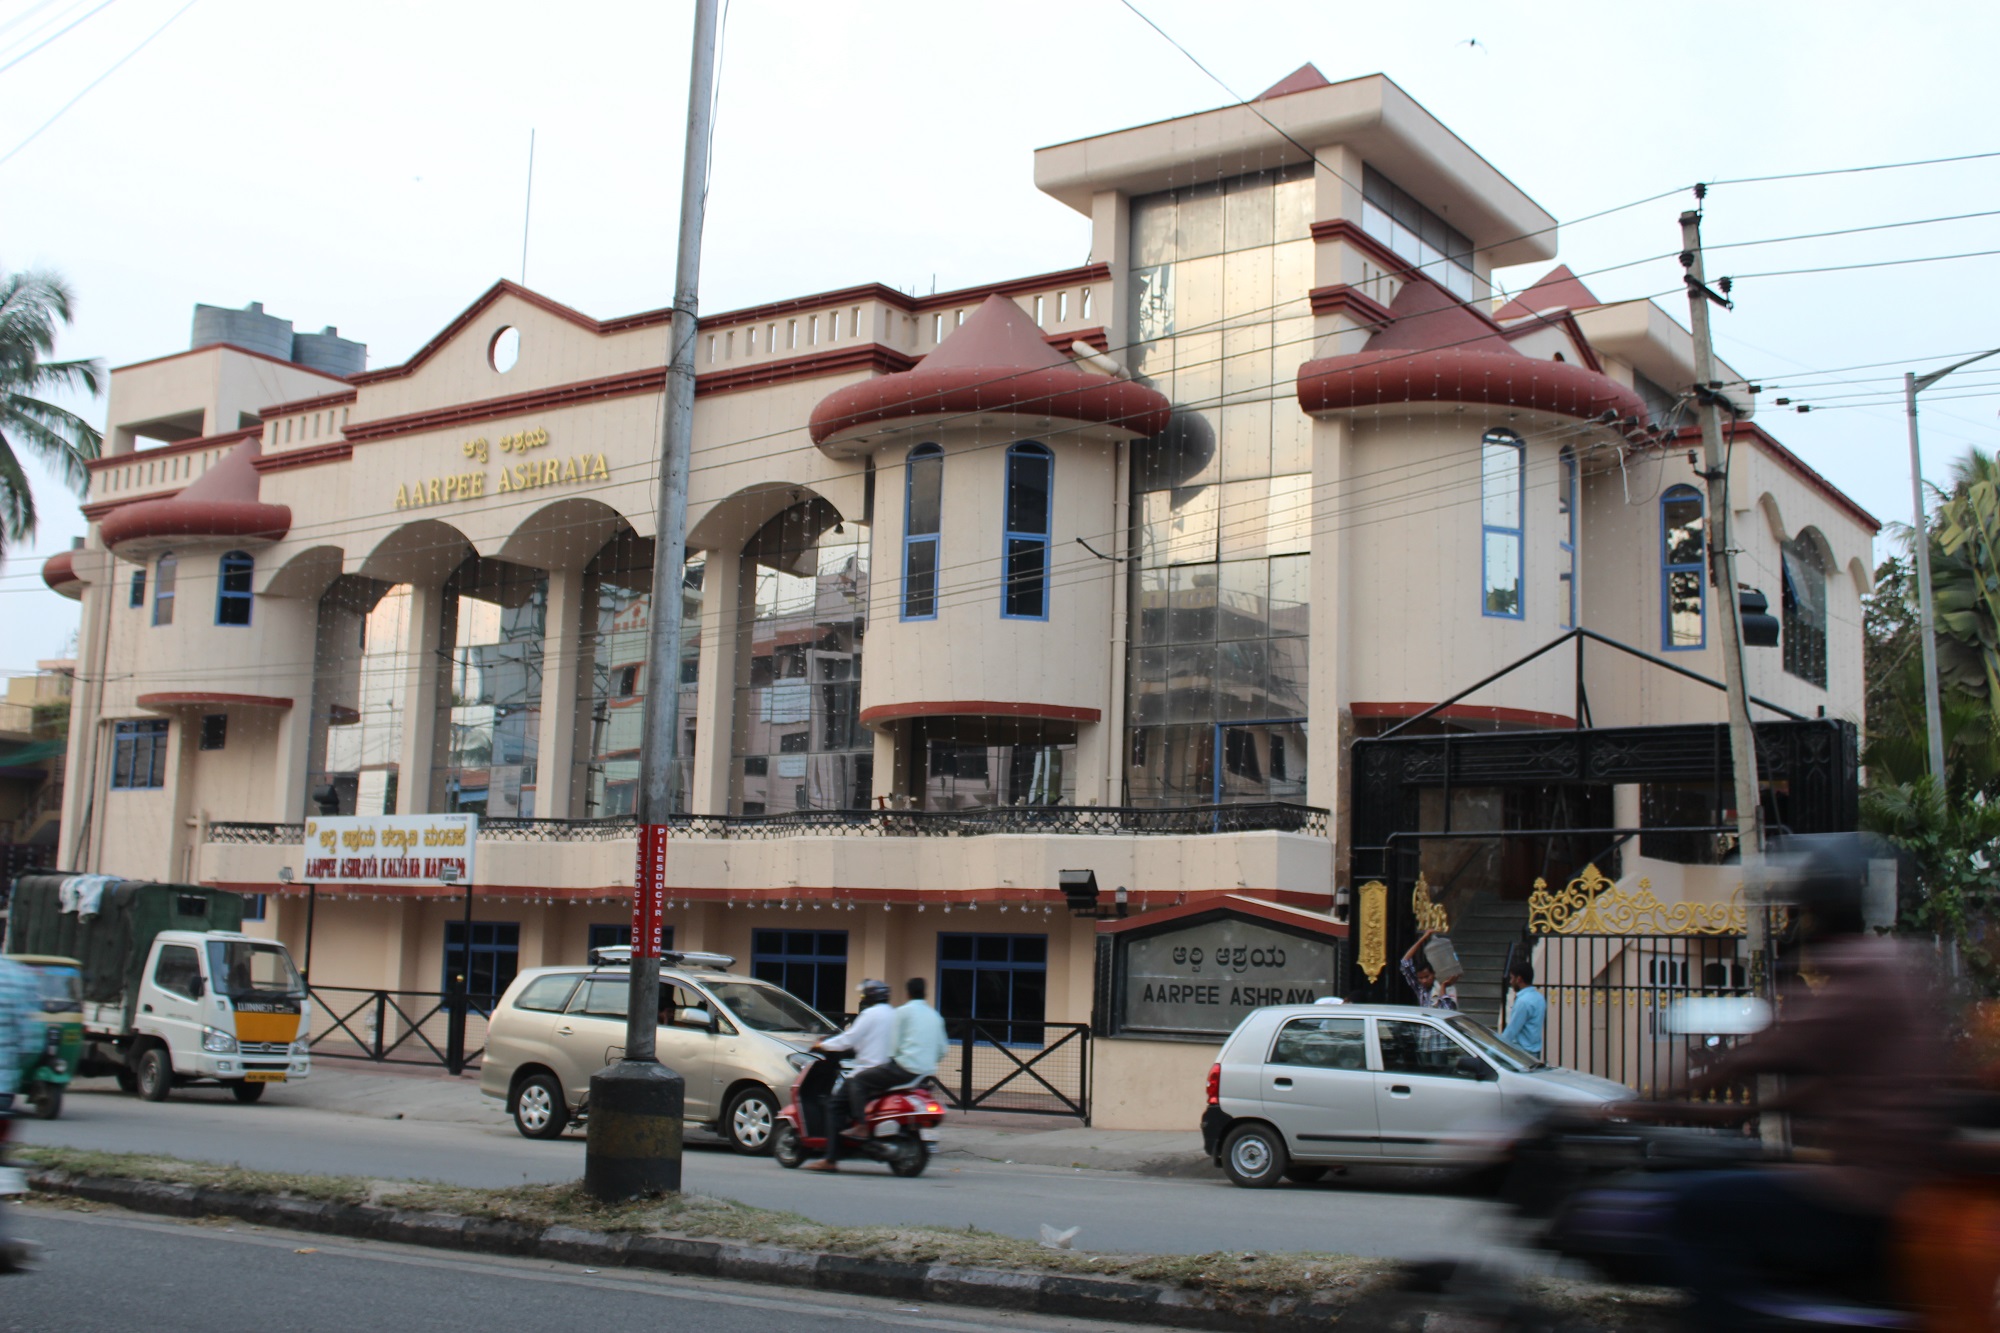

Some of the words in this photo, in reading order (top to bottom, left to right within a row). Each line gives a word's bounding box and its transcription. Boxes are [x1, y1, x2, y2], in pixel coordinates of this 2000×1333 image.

[393, 471, 487, 508] AARPEE
[497, 453, 609, 494] ASHRAYA
[305, 858, 337, 879] AARPEE
[340, 858, 377, 879] ASHRAYA
[381, 858, 420, 878] KALYANA
[1215, 944, 1286, 973] ಆಶ್ರಯ
[1143, 983, 1220, 1005] AARPEE
[1230, 987, 1315, 1006] ASHRAYA
[237, 1002, 273, 1012] WINNER
